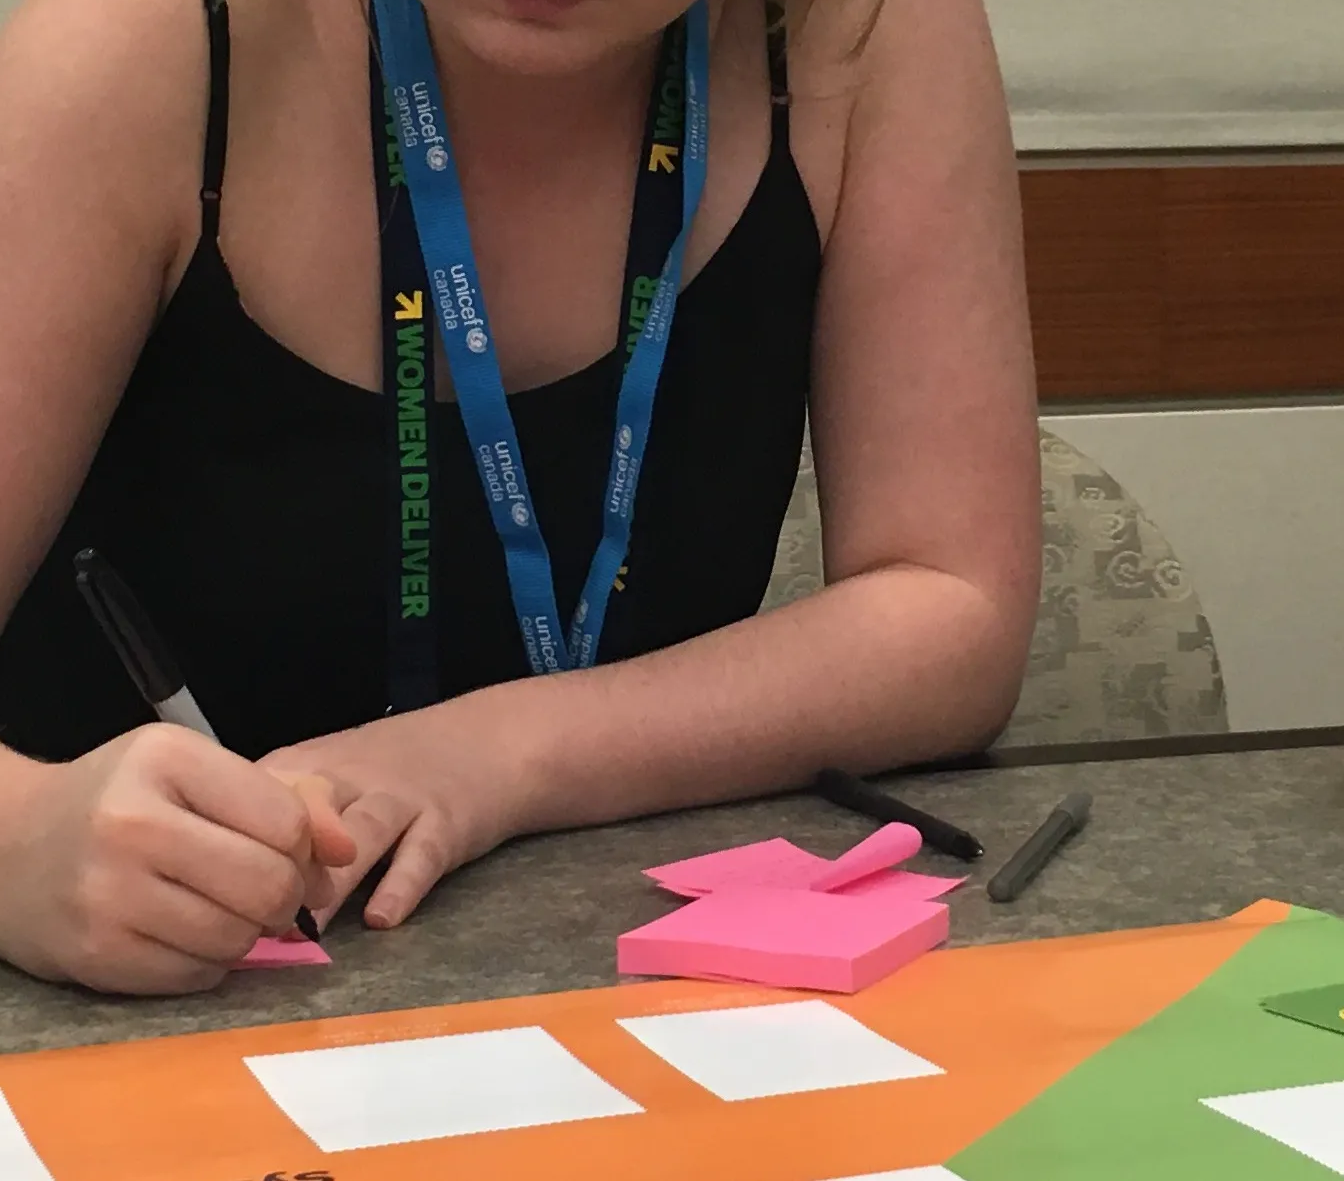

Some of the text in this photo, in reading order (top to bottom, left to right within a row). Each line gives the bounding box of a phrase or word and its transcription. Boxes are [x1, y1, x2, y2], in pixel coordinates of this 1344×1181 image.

[394, 86, 417, 148] canada
[411, 81, 445, 144] unicef
[433, 269, 458, 330] canada
[450, 264, 484, 326] unicef
[644, 278, 668, 339] unicef
[396, 324, 430, 619] WOMEN DELIVER
[478, 444, 504, 503] canada
[494, 440, 526, 500] unicef
[609, 449, 630, 513] unicef
